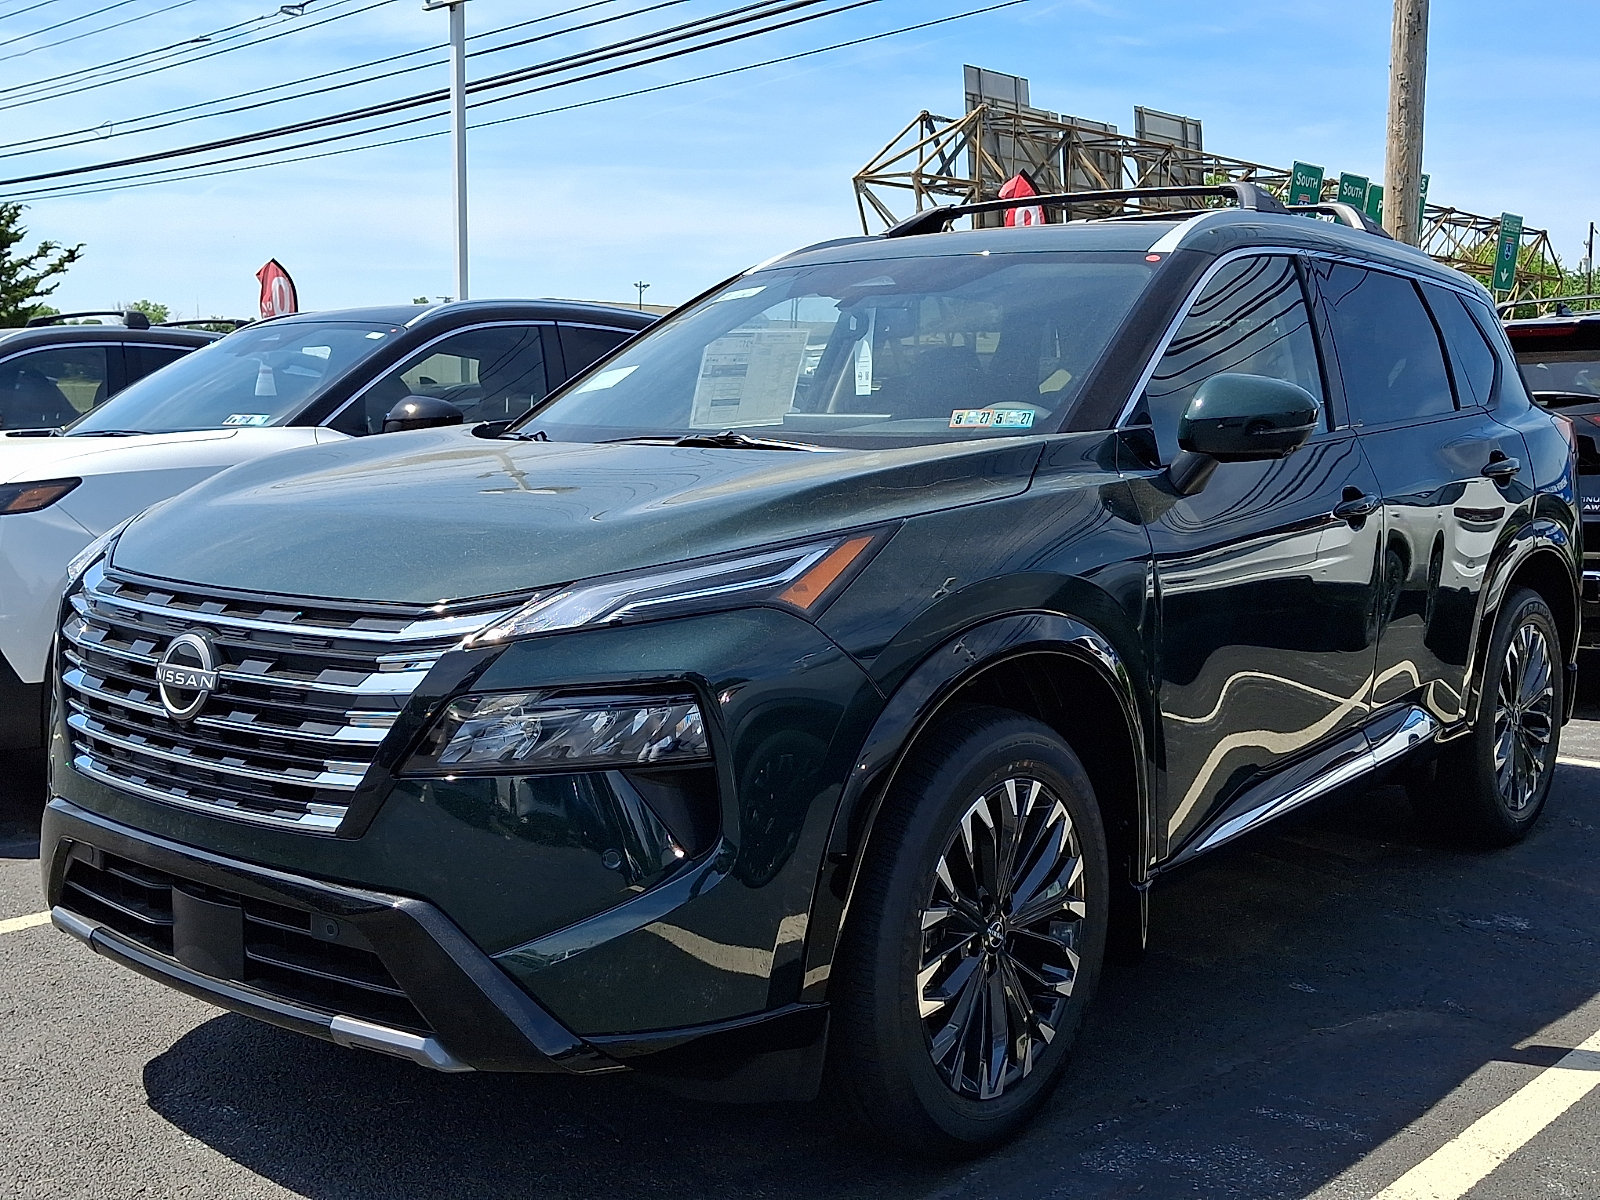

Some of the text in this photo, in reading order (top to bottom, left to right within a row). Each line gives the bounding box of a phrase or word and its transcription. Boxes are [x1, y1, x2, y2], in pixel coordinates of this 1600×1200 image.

[1295, 171, 1319, 189] SOUTH
[1342, 182, 1364, 199] SOUTH
[979, 412, 990, 424] 27
[1020, 412, 1031, 424] 27
[156, 666, 214, 689] NISSAN
